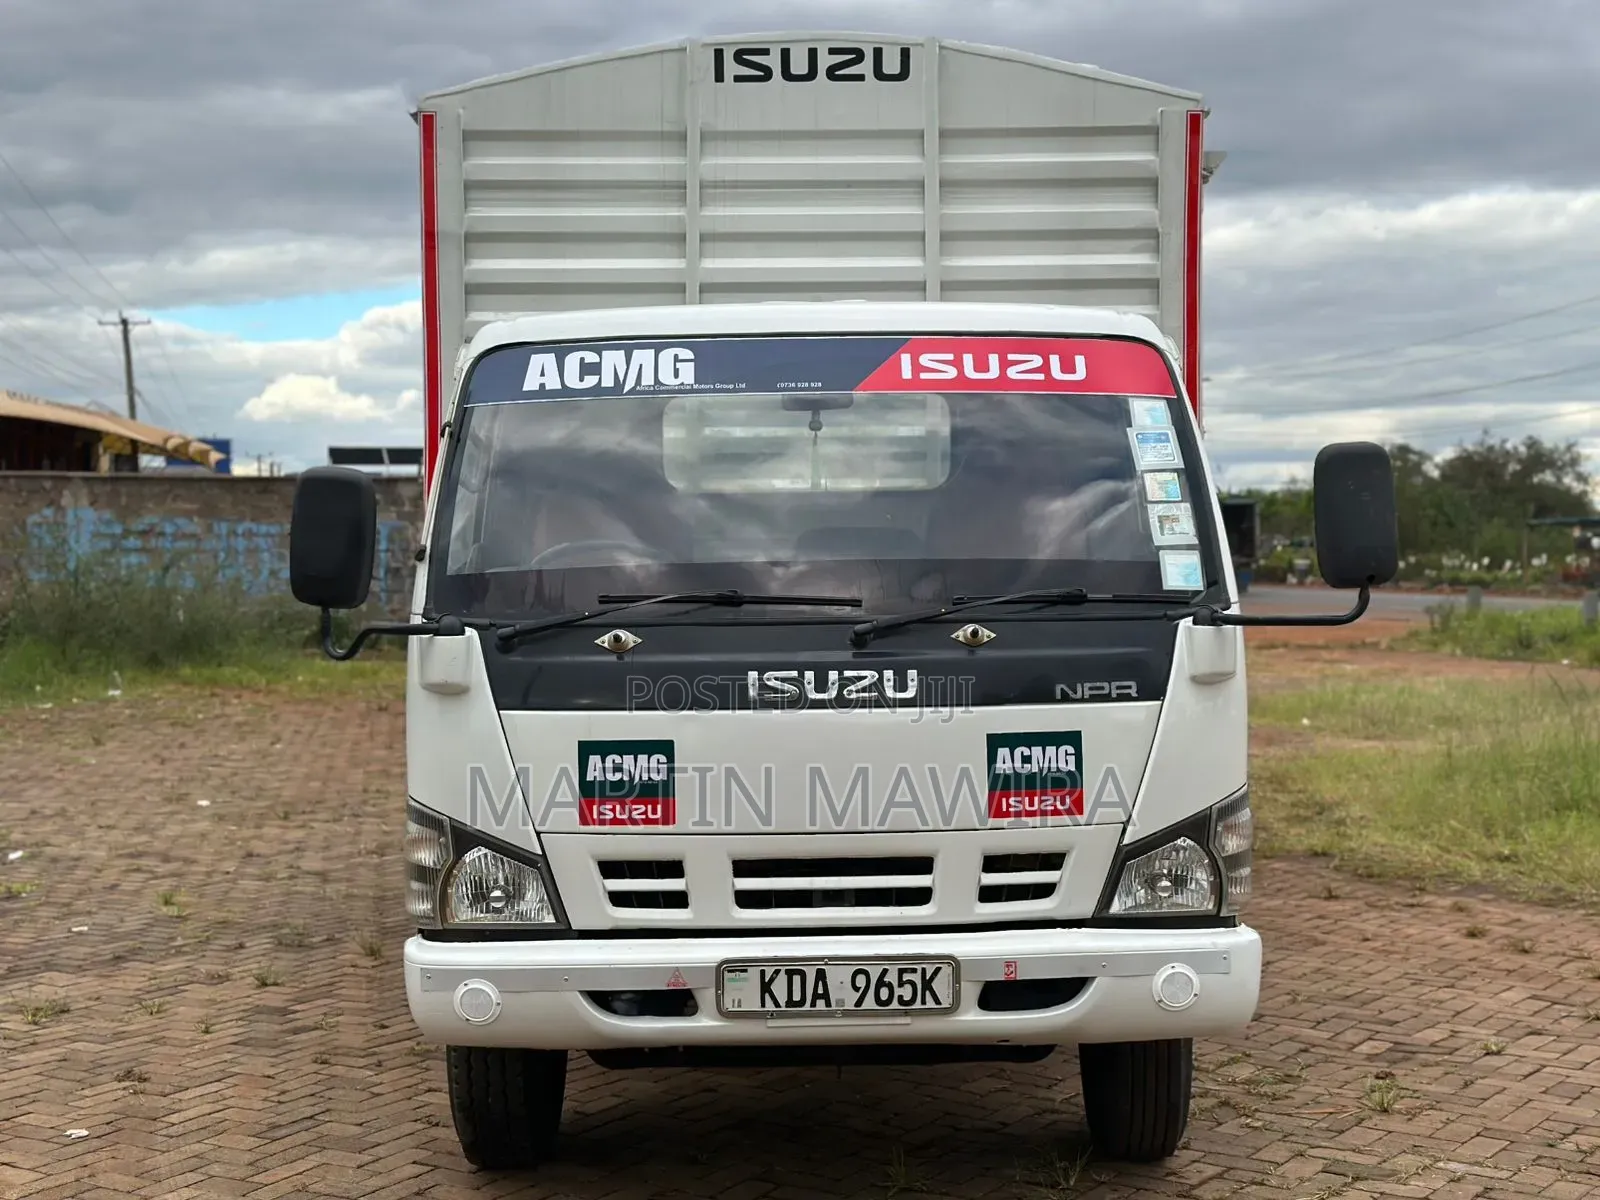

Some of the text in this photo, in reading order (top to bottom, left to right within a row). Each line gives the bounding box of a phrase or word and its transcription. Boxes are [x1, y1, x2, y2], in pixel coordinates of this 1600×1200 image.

[714, 47, 911, 83] ISUZU
[522, 348, 696, 394] ACMG
[900, 353, 1087, 381] ISUZU
[747, 670, 918, 700] ISUZU
[1055, 681, 1139, 699] NPR
[586, 754, 668, 785] ACMG
[994, 744, 1076, 777] ACMG
[592, 804, 663, 820] ISUZU
[1001, 795, 1071, 812] ISUZU
[760, 967, 833, 1009] KDA
[850, 966, 943, 1009] 965K
